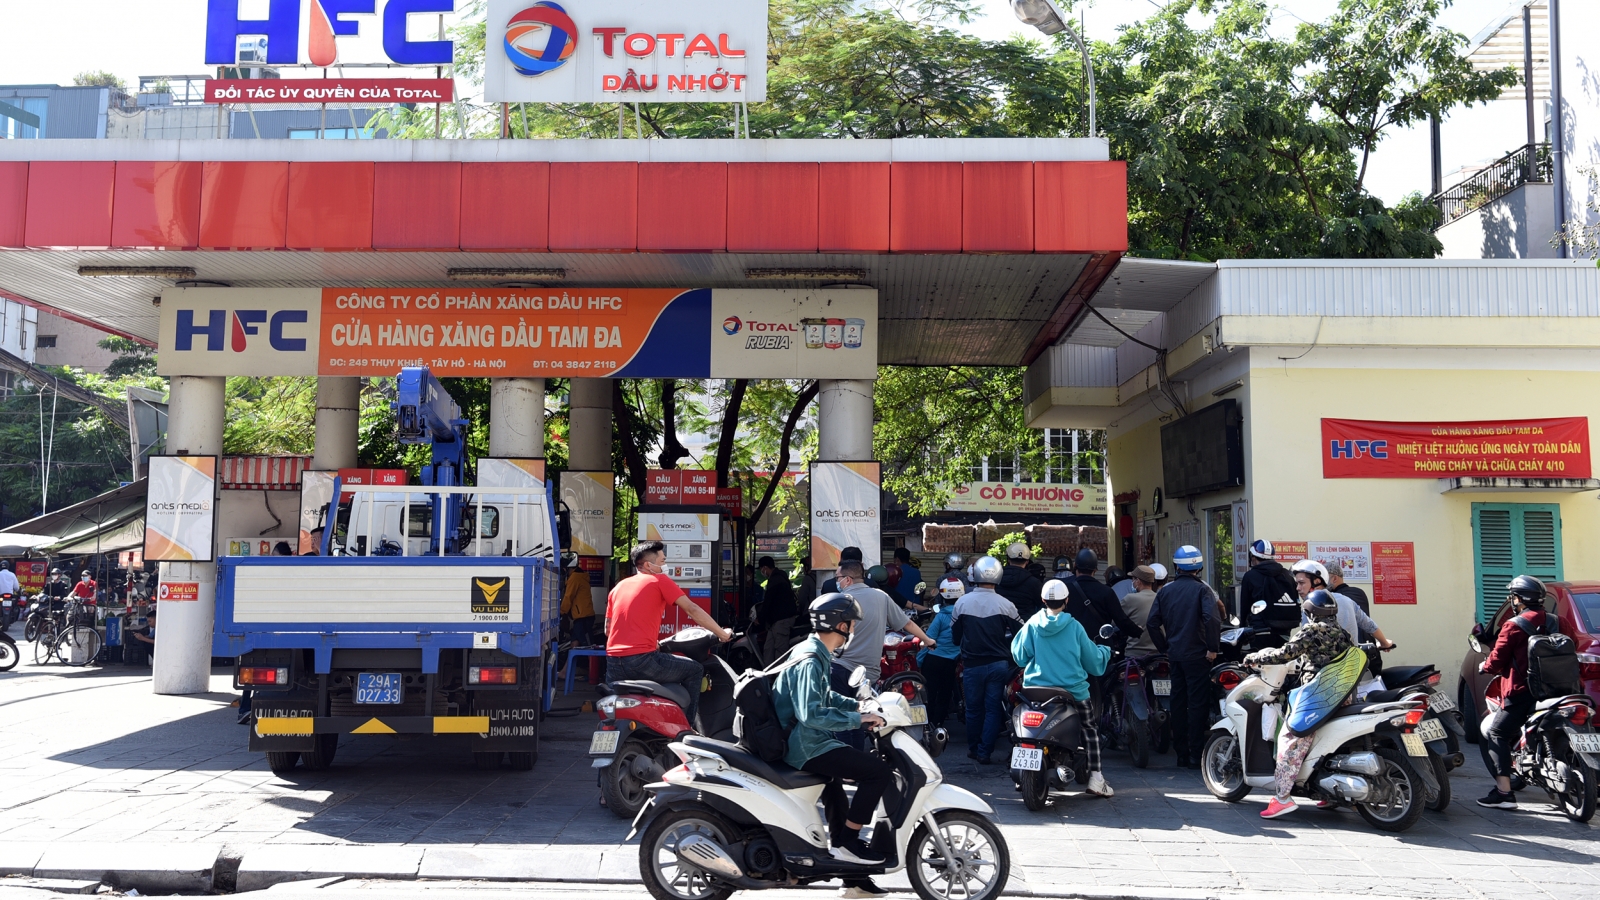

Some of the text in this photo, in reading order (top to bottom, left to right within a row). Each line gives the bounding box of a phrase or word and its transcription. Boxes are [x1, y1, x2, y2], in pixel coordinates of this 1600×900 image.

[205, 0, 454, 66] HFC
[592, 27, 746, 58] TOTAL
[603, 67, 746, 92] DẦU NHỚT
[214, 84, 442, 99] ĐỐI TÁC ỦY QUYỀN CỦA TOTAL
[336, 292, 622, 310] CÔNG TY CỔ PHẦN XĂNG DẦU HFC
[174, 309, 308, 352] HFC
[331, 317, 622, 348] CỬA HÀNG XĂNG DẦU TAM ĐA
[746, 320, 798, 332] TOTAL
[745, 336, 790, 350] RUBIA
[330, 358, 346, 366] ĐC:
[348, 358, 368, 366] 249
[371, 359, 396, 368] THỤY
[398, 358, 423, 366] KHUÊ
[432, 358, 448, 368] TÂY
[474, 358, 486, 368] HÀ
[490, 358, 506, 370] NỘI
[566, 361, 591, 369] 3847
[594, 361, 616, 369] 2118
[1449, 427, 1471, 435] HÀNG
[1473, 426, 1494, 435] XĂNG
[1330, 440, 1388, 459] HFC
[1396, 440, 1581, 457] NHIỆT LIỆT HƯỞNG ỨNG NGÀY TOÀN DÂN
[1414, 458, 1565, 472] PHÒNG CHÁY VÀ CHỮA CHÁY 4/10
[980, 484, 1006, 500] CÔ
[1012, 486, 1084, 501] PHƯƠNG
[368, 674, 390, 688] 29A
[358, 689, 399, 702] 027.33
[512, 709, 534, 720] AUTO
[490, 726, 534, 737] 1900.0108
[1017, 749, 1038, 759] 29-AB
[1014, 759, 1039, 769] 243.60
